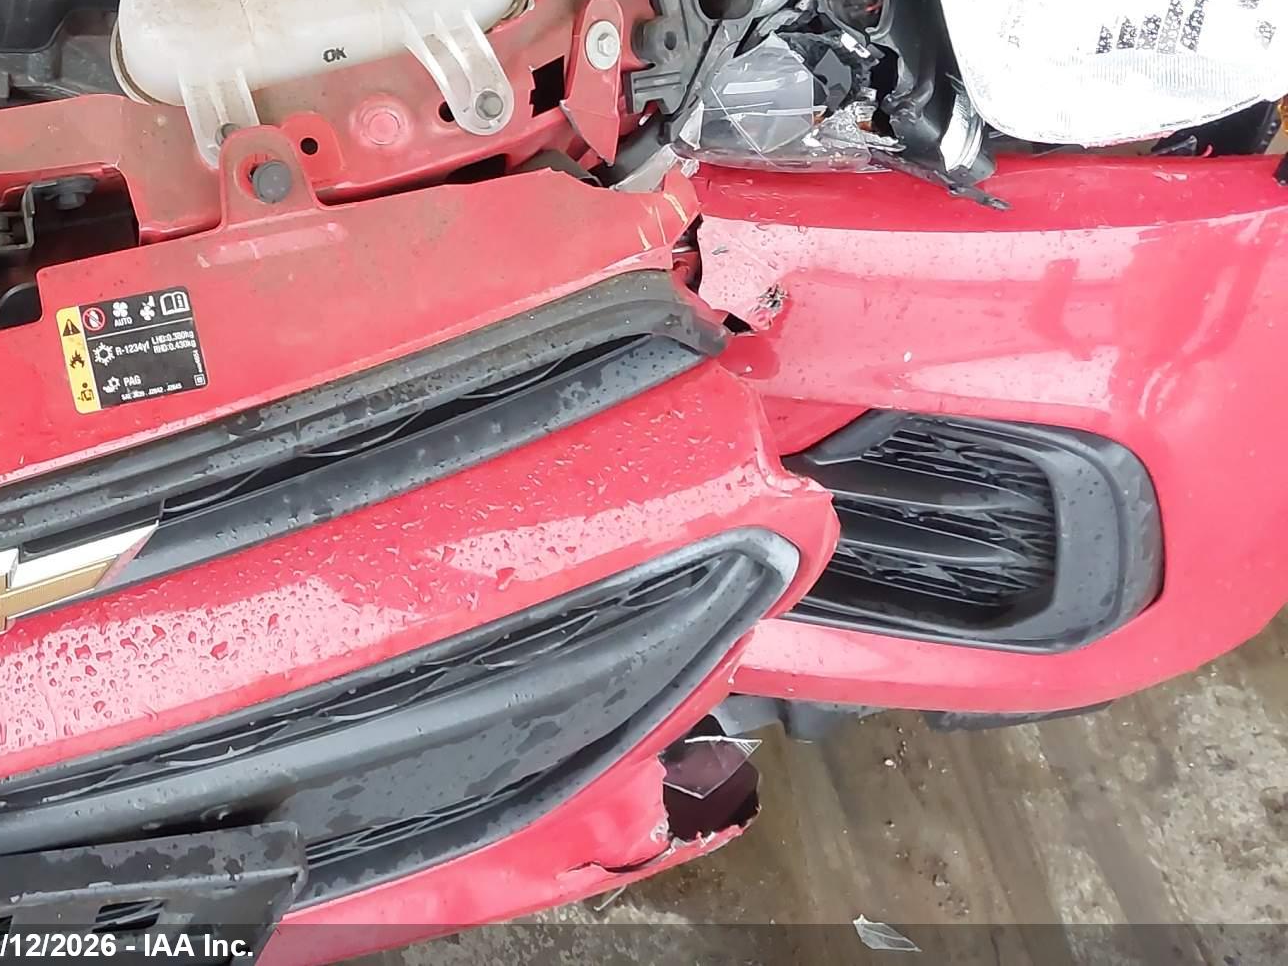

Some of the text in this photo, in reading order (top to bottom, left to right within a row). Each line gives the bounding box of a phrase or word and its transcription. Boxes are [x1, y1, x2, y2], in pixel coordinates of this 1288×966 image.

[323, 47, 347, 63] OK
[114, 317, 133, 327] AUTO
[123, 375, 142, 387] PAG
